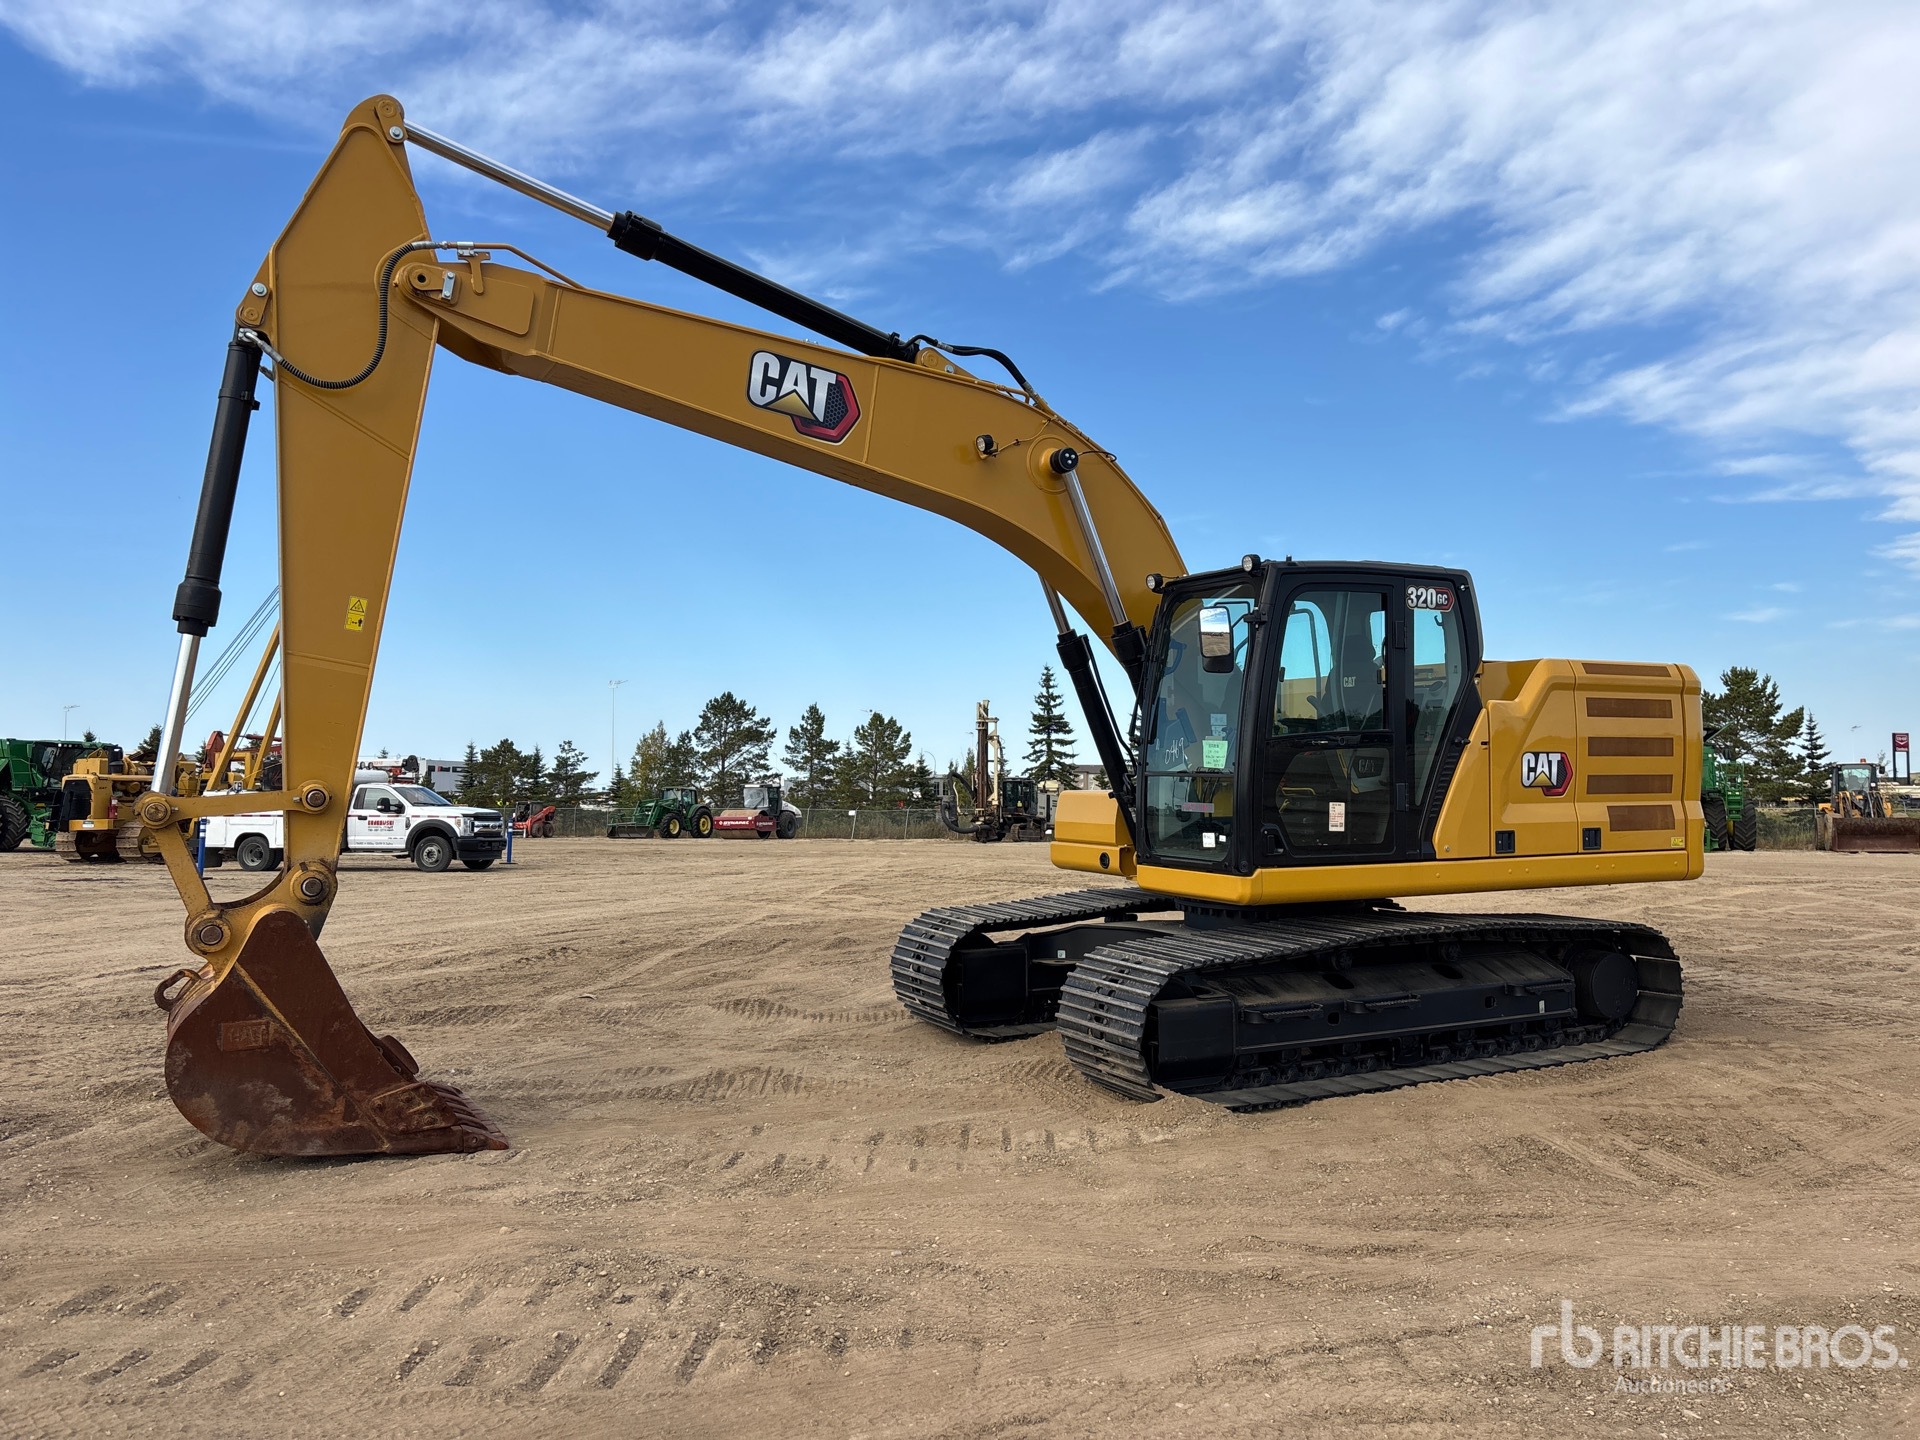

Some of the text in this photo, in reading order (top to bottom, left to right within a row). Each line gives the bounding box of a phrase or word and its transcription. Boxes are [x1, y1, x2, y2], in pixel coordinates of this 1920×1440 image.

[749, 351, 837, 423] CAT
[1343, 676, 1356, 688] CAT
[1522, 752, 1561, 787] CAT
